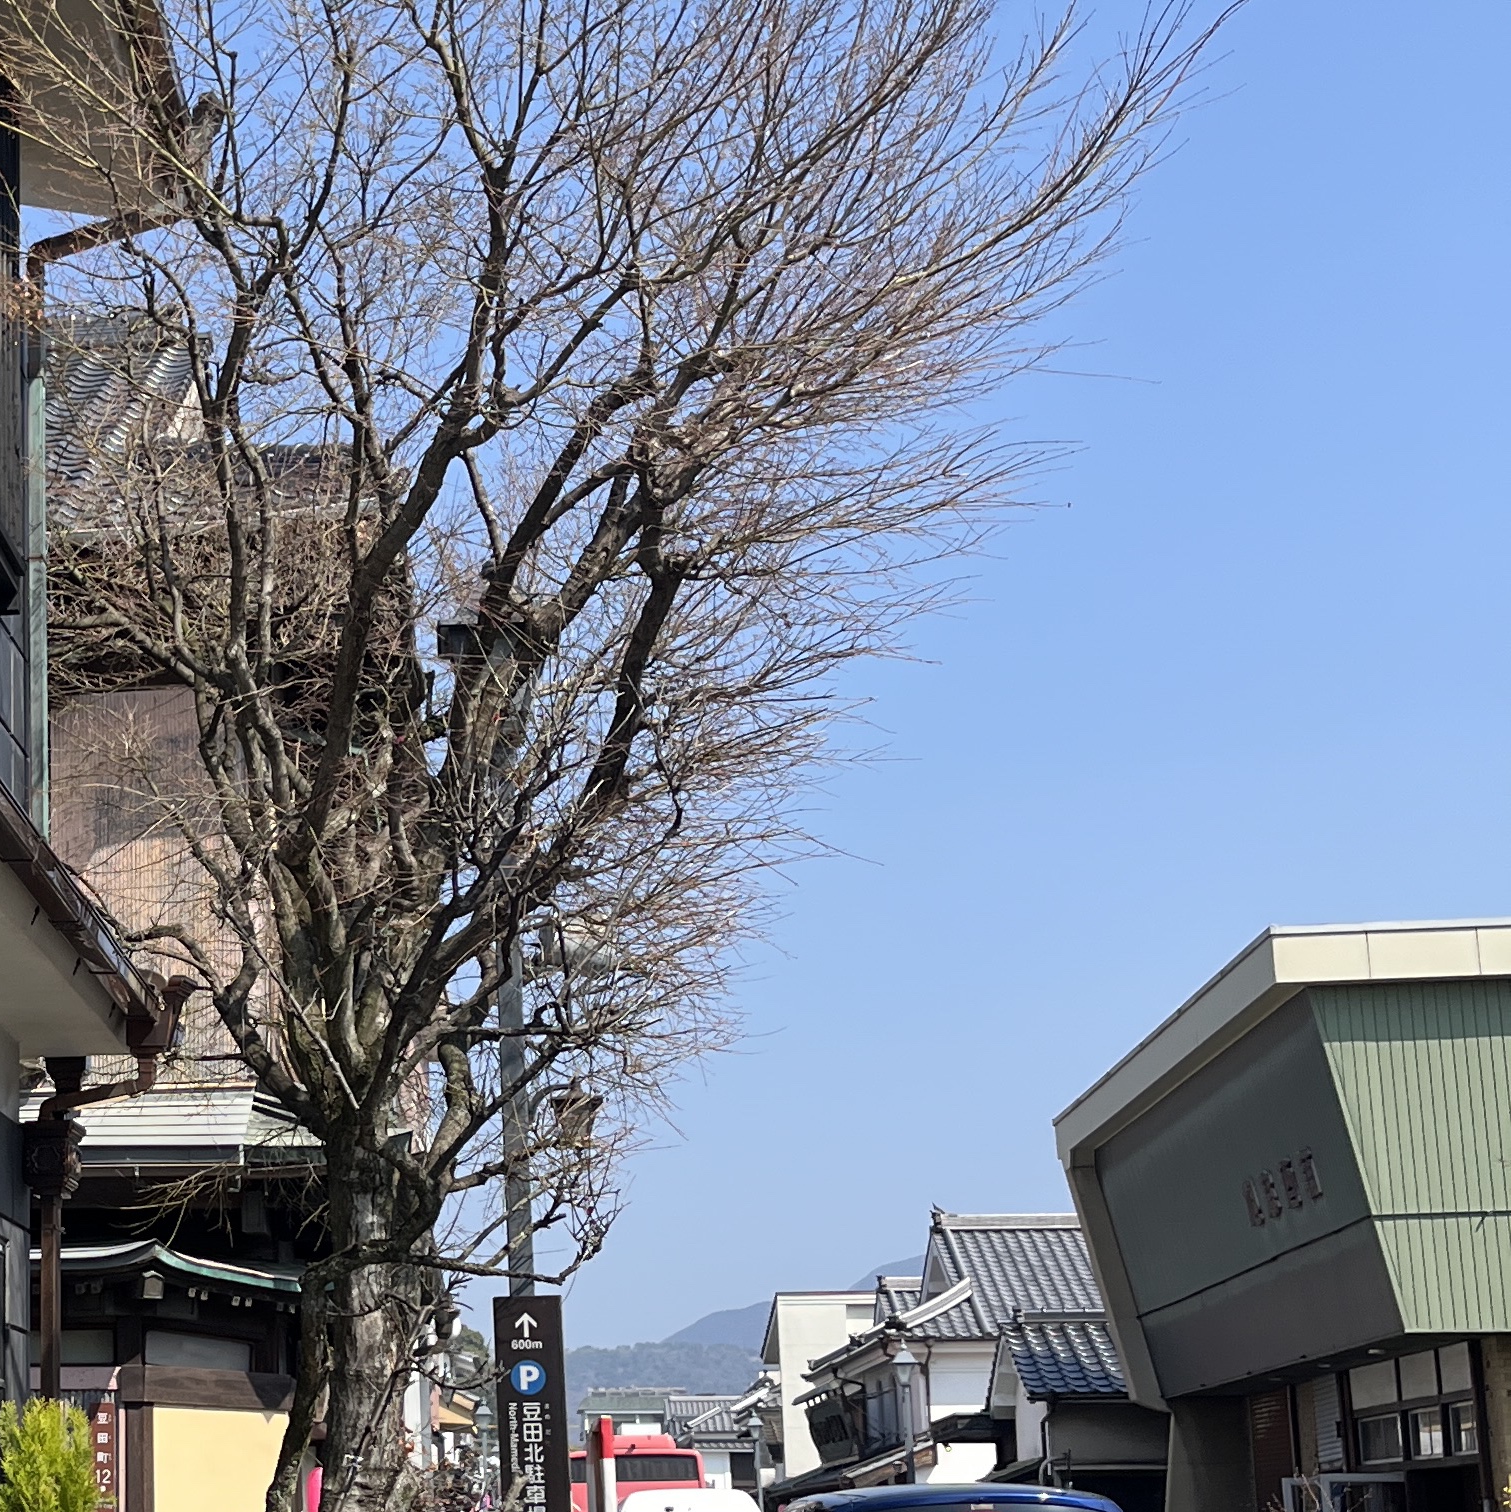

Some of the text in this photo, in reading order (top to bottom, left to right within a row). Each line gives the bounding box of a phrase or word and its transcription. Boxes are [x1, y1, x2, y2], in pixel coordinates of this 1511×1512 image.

[510, 1339, 543, 1350] 600m
[519, 1366, 539, 1390] P
[96, 1411, 109, 1464] 豆田町
[95, 1469, 111, 1484] 12
